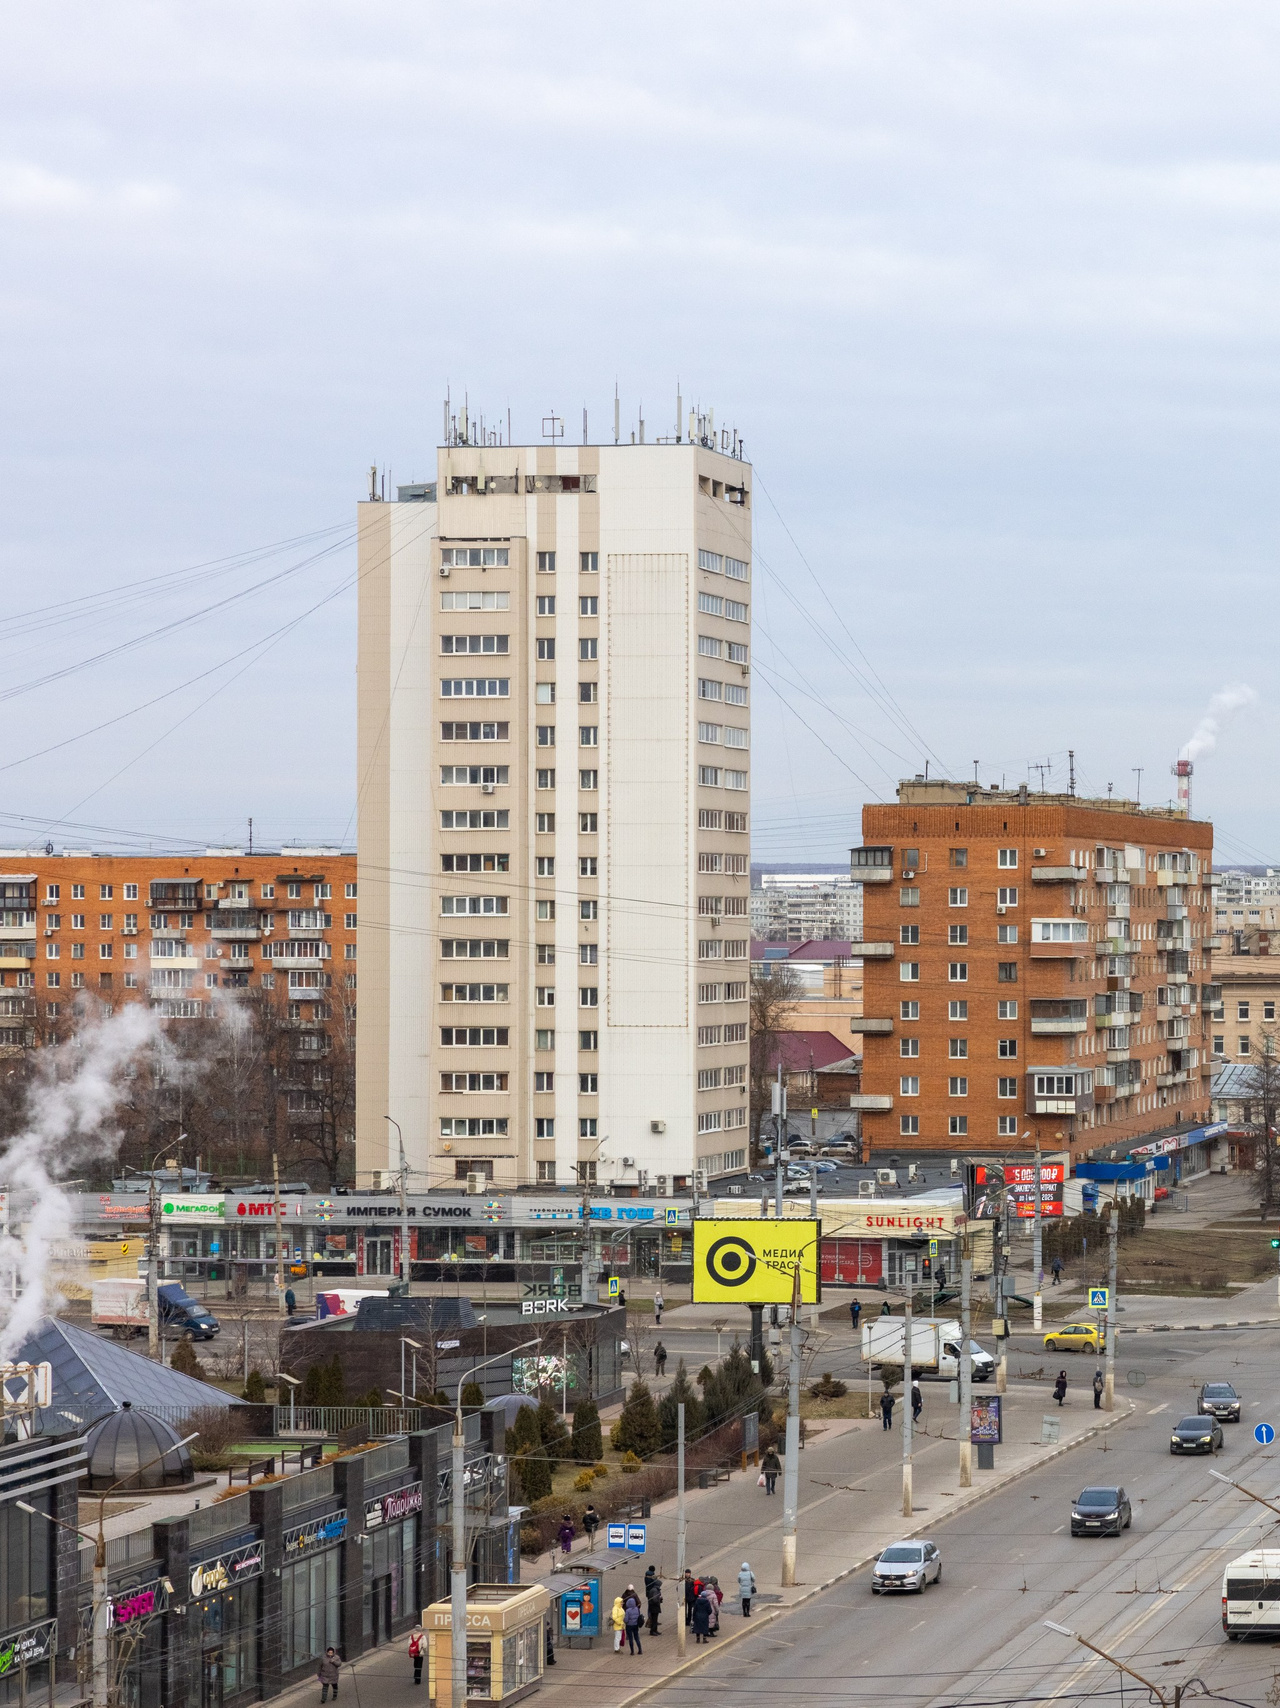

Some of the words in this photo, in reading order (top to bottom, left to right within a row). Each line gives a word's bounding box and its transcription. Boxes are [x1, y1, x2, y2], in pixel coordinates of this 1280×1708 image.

[347, 1206, 416, 1217] ИМПЕРИЯ
[423, 1206, 471, 1217] СУМОК
[617, 1207, 655, 1219] ГОШ
[866, 1216, 944, 1228] SUNLIGHT
[763, 1249, 804, 1259] МЕДИА
[522, 1298, 569, 1315] BORK
[385, 1490, 423, 1521] Подружка
[517, 1601, 536, 1619] ПРЕССА
[434, 1614, 491, 1627] ПРССА
